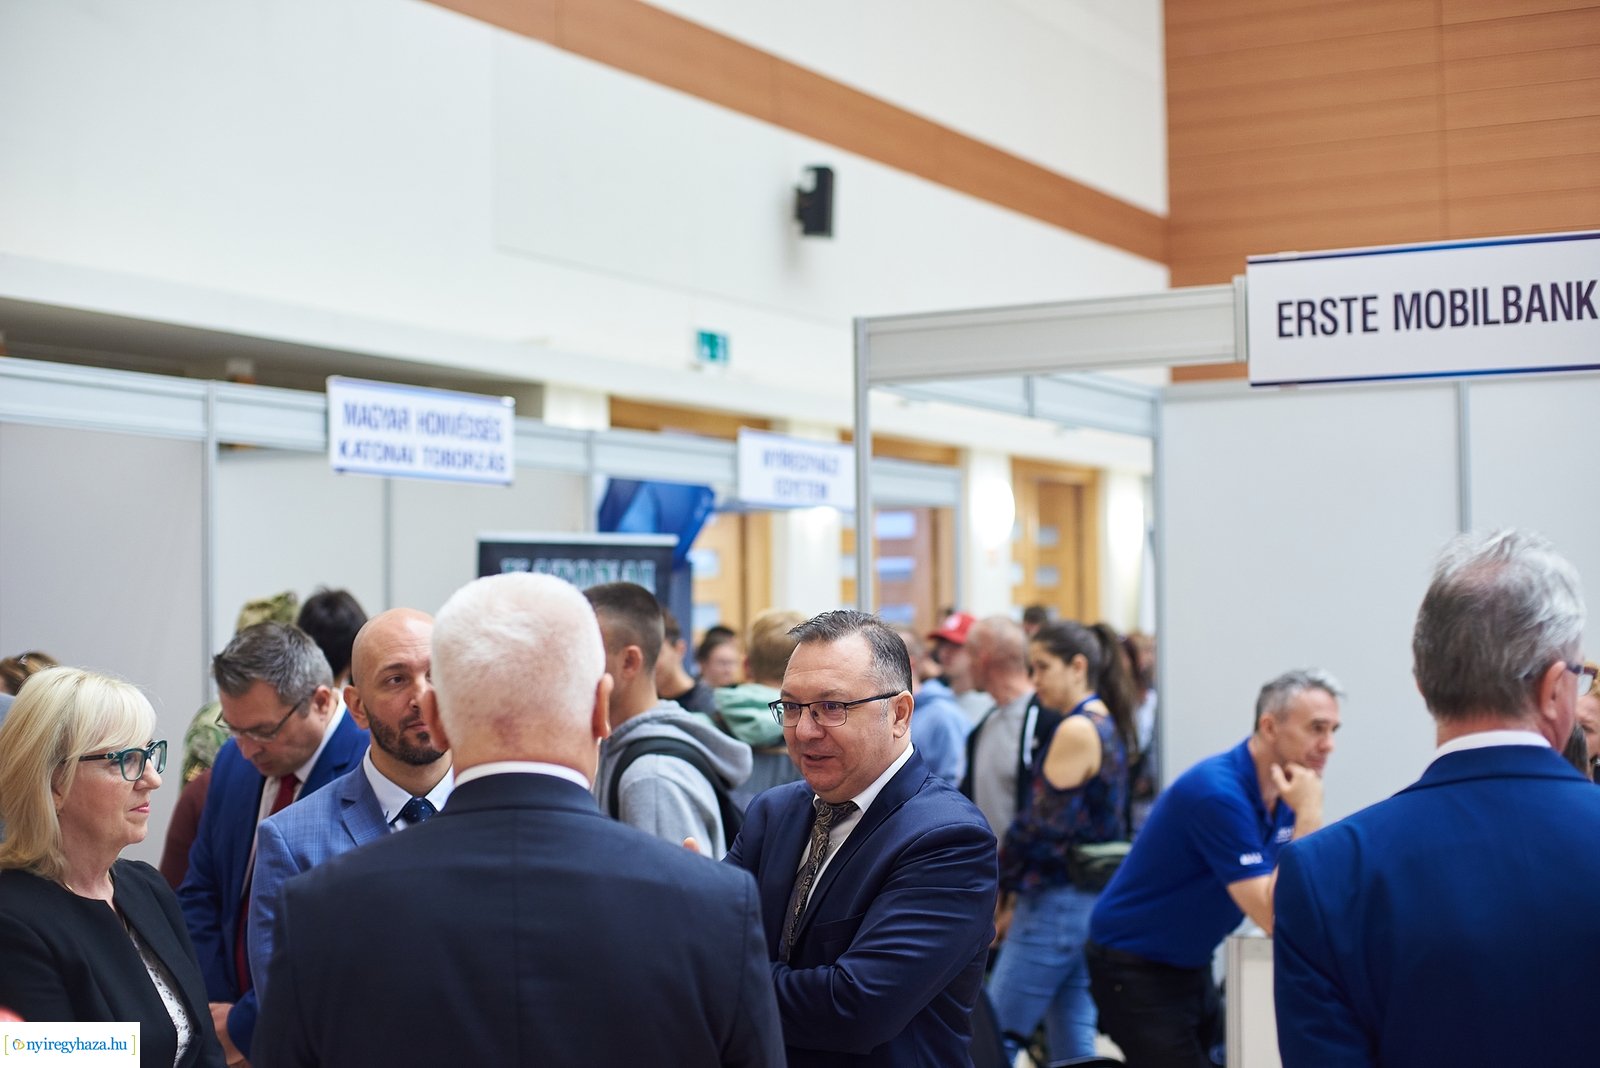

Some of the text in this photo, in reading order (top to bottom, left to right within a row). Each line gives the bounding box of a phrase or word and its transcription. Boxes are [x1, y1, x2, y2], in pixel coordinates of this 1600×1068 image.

[1277, 279, 1599, 338] ERSTE MOBILBANK
[343, 402, 410, 431] MAGYAR
